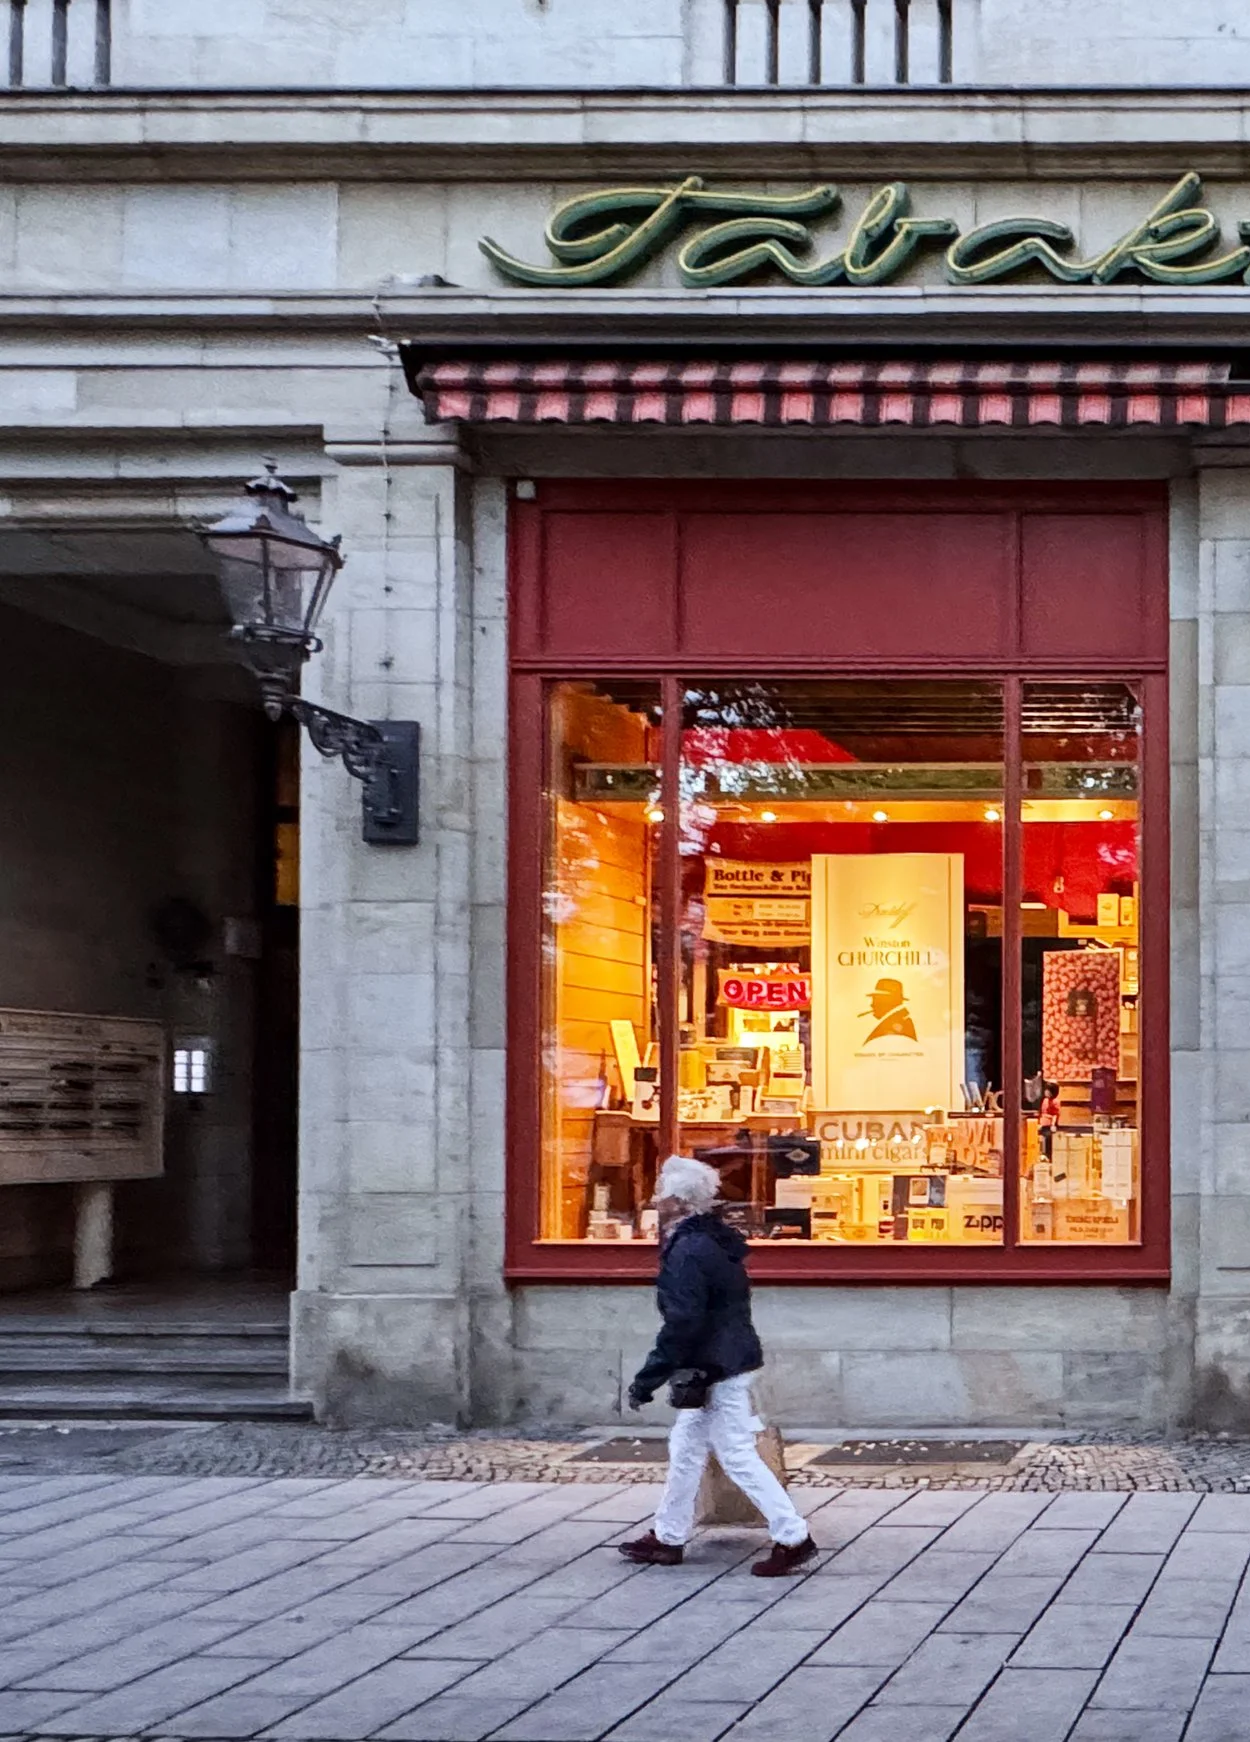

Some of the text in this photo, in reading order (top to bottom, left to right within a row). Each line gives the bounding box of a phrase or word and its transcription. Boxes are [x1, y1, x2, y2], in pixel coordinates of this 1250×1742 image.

[714, 869, 764, 881] Bottle
[771, 870, 784, 882] &
[837, 951, 938, 967] CHURCHILL
[723, 979, 808, 1003] OPEN
[963, 1215, 1004, 1232] Zipp
